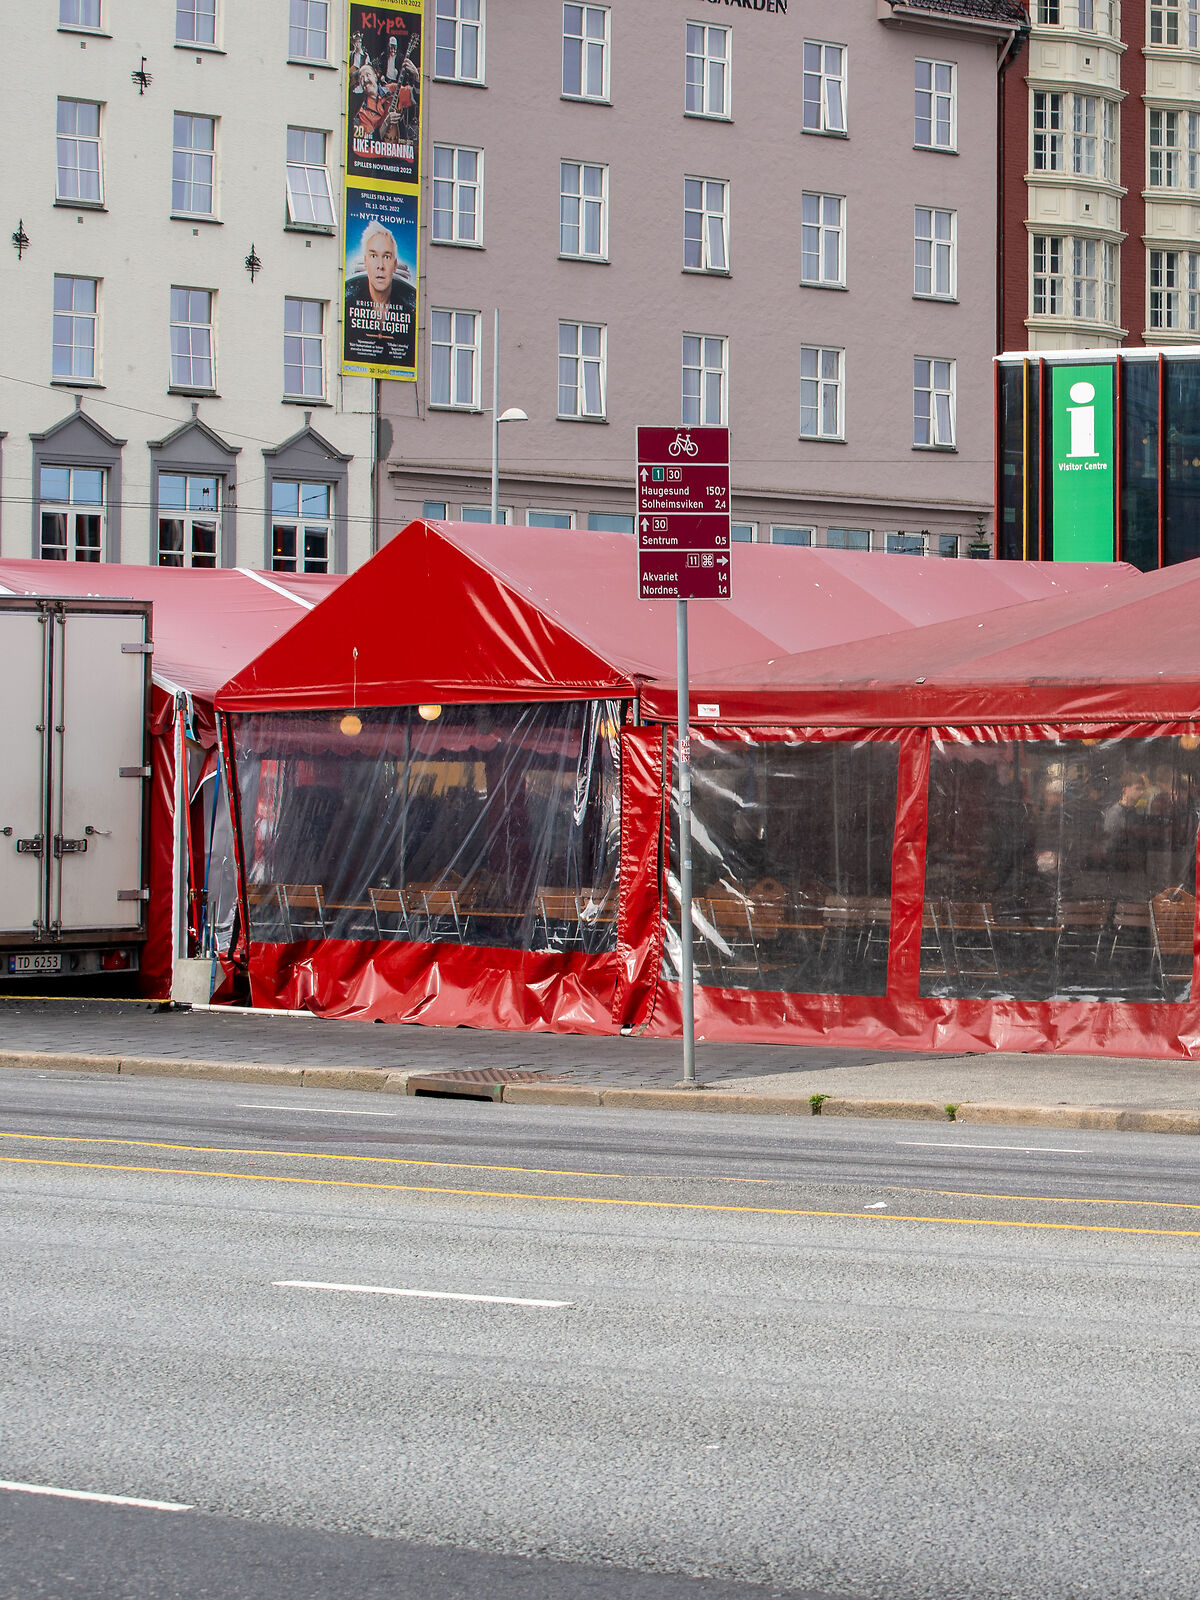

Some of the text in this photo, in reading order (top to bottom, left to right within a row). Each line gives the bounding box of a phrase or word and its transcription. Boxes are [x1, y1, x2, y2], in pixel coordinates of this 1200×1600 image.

[361, 12, 406, 35] Klypa
[353, 125, 364, 138] 20
[353, 138, 415, 160] LIKE FORBANNA
[354, 160, 413, 174] SPILLES NOVEMBER 2022
[360, 192, 377, 200] SPILLES
[359, 212, 380, 221] NYTT
[356, 300, 404, 311] KRISTIAN VALEN
[349, 307, 411, 324] FARTØY VALEN
[351, 318, 409, 335] SEILER IGJEN!
[1058, 462, 1107, 471] Visitor Centre
[655, 469, 680, 480] 1 30
[641, 486, 726, 498] Haugesund 150,7
[641, 499, 727, 510] Solheimsviken 2,4
[654, 519, 666, 529] 30
[642, 536, 727, 546] Sentrum 0,5
[689, 556, 698, 566] 11
[642, 572, 727, 582] Akvariet 1,4
[642, 585, 728, 595] Nordnes 1,4
[18, 956, 58, 969] TD 6253
